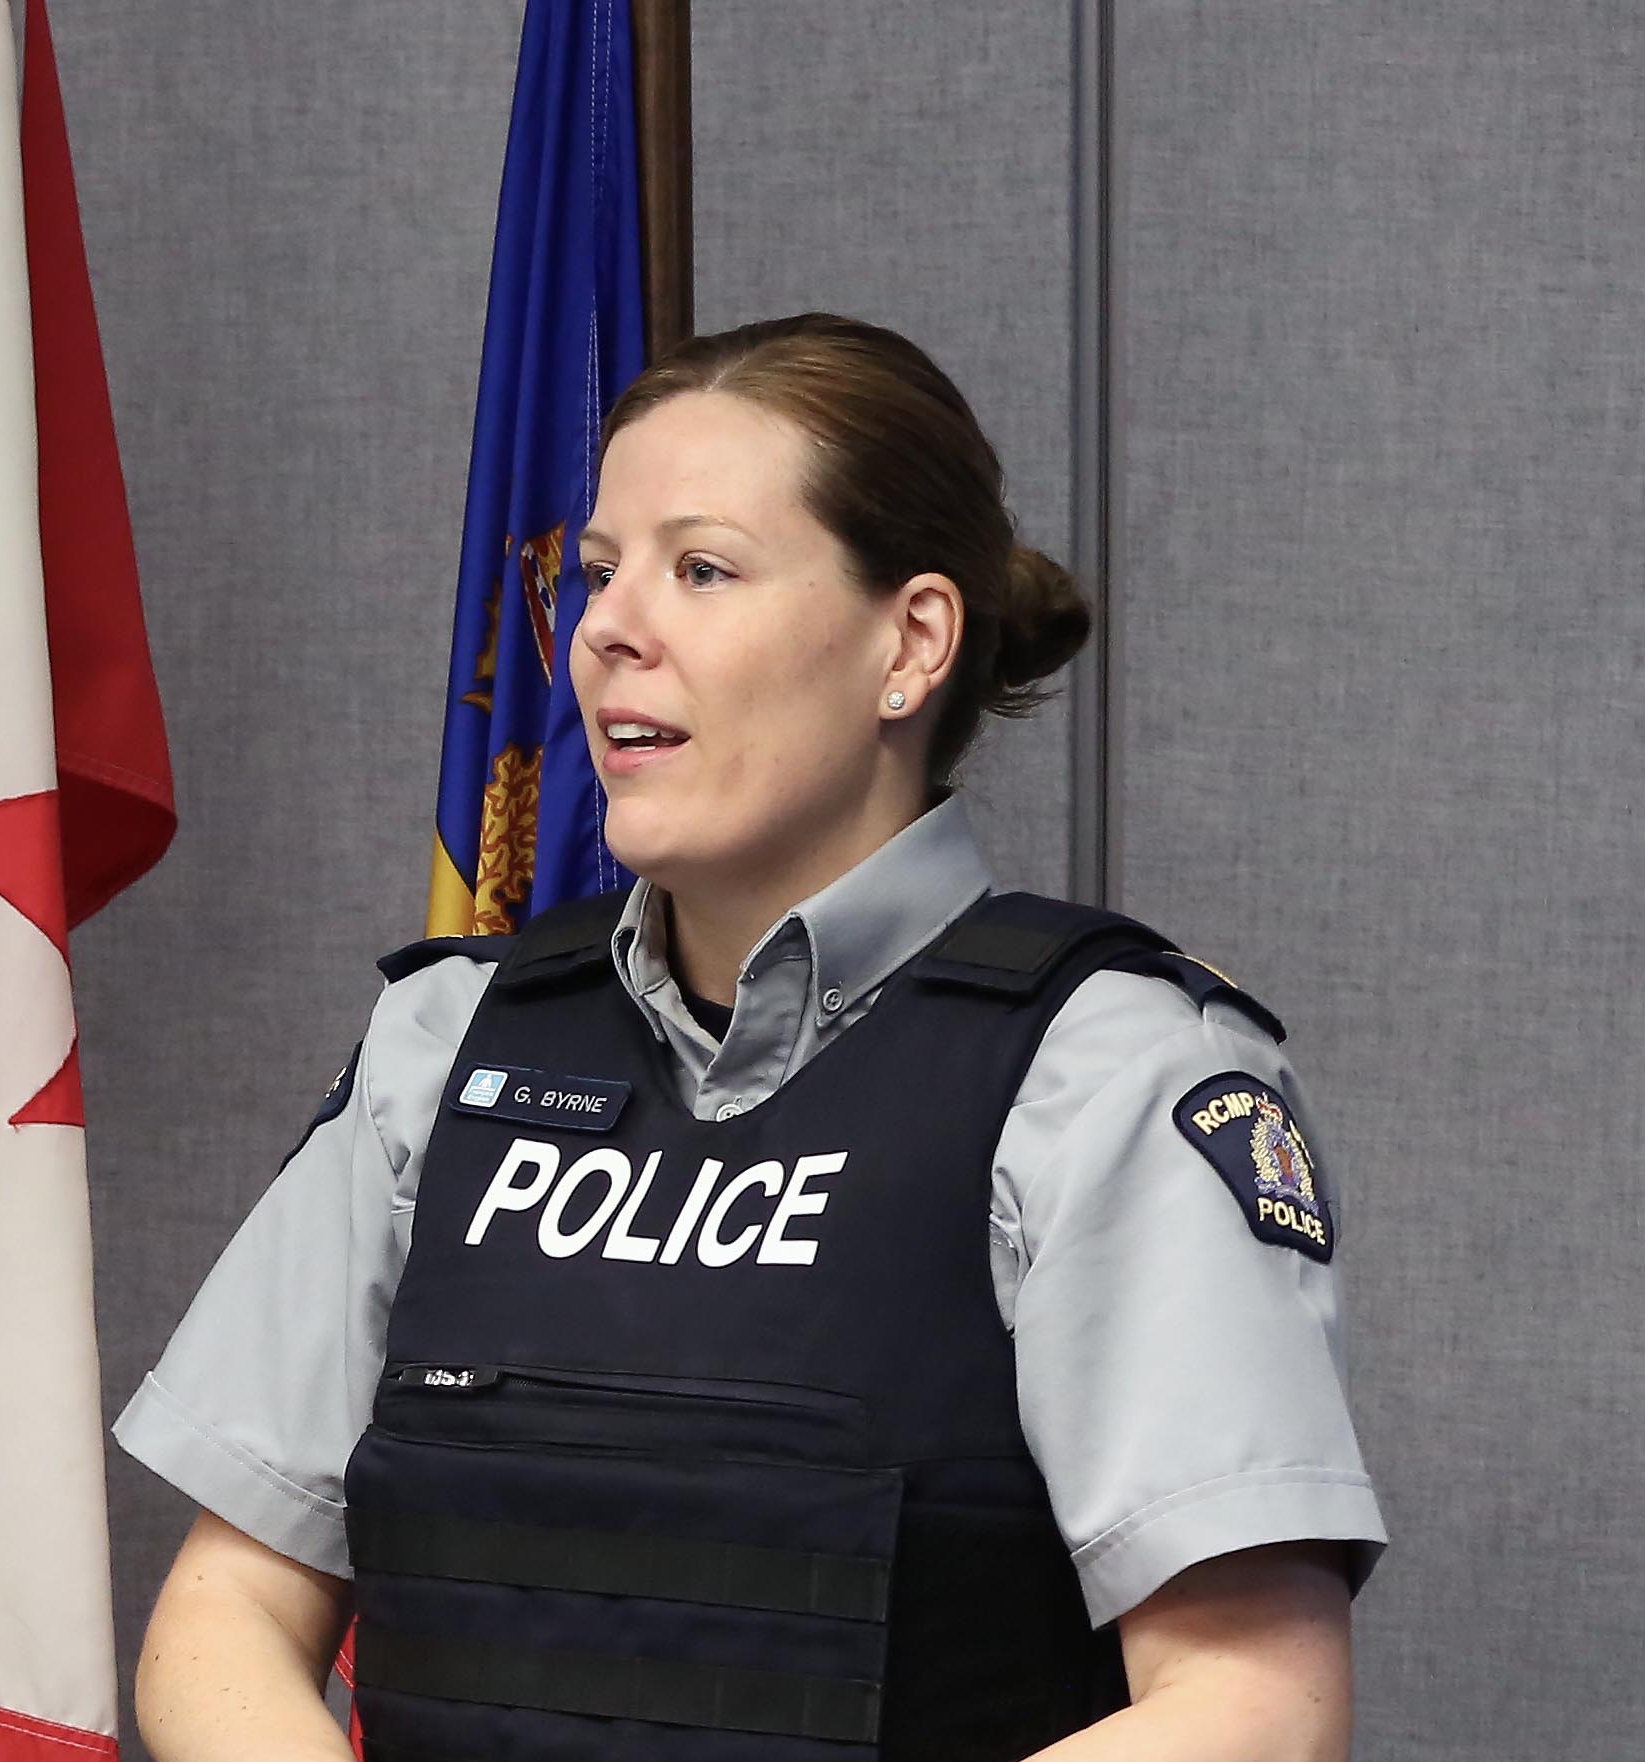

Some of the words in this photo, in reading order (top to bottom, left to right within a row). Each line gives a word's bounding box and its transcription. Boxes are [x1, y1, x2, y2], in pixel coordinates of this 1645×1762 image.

[514, 1086, 532, 1105] G.
[540, 1090, 608, 1114] BYRNE
[1191, 1091, 1256, 1136] RCMP
[463, 1137, 850, 1268] POLICE
[1257, 1196, 1327, 1246] POLICE
